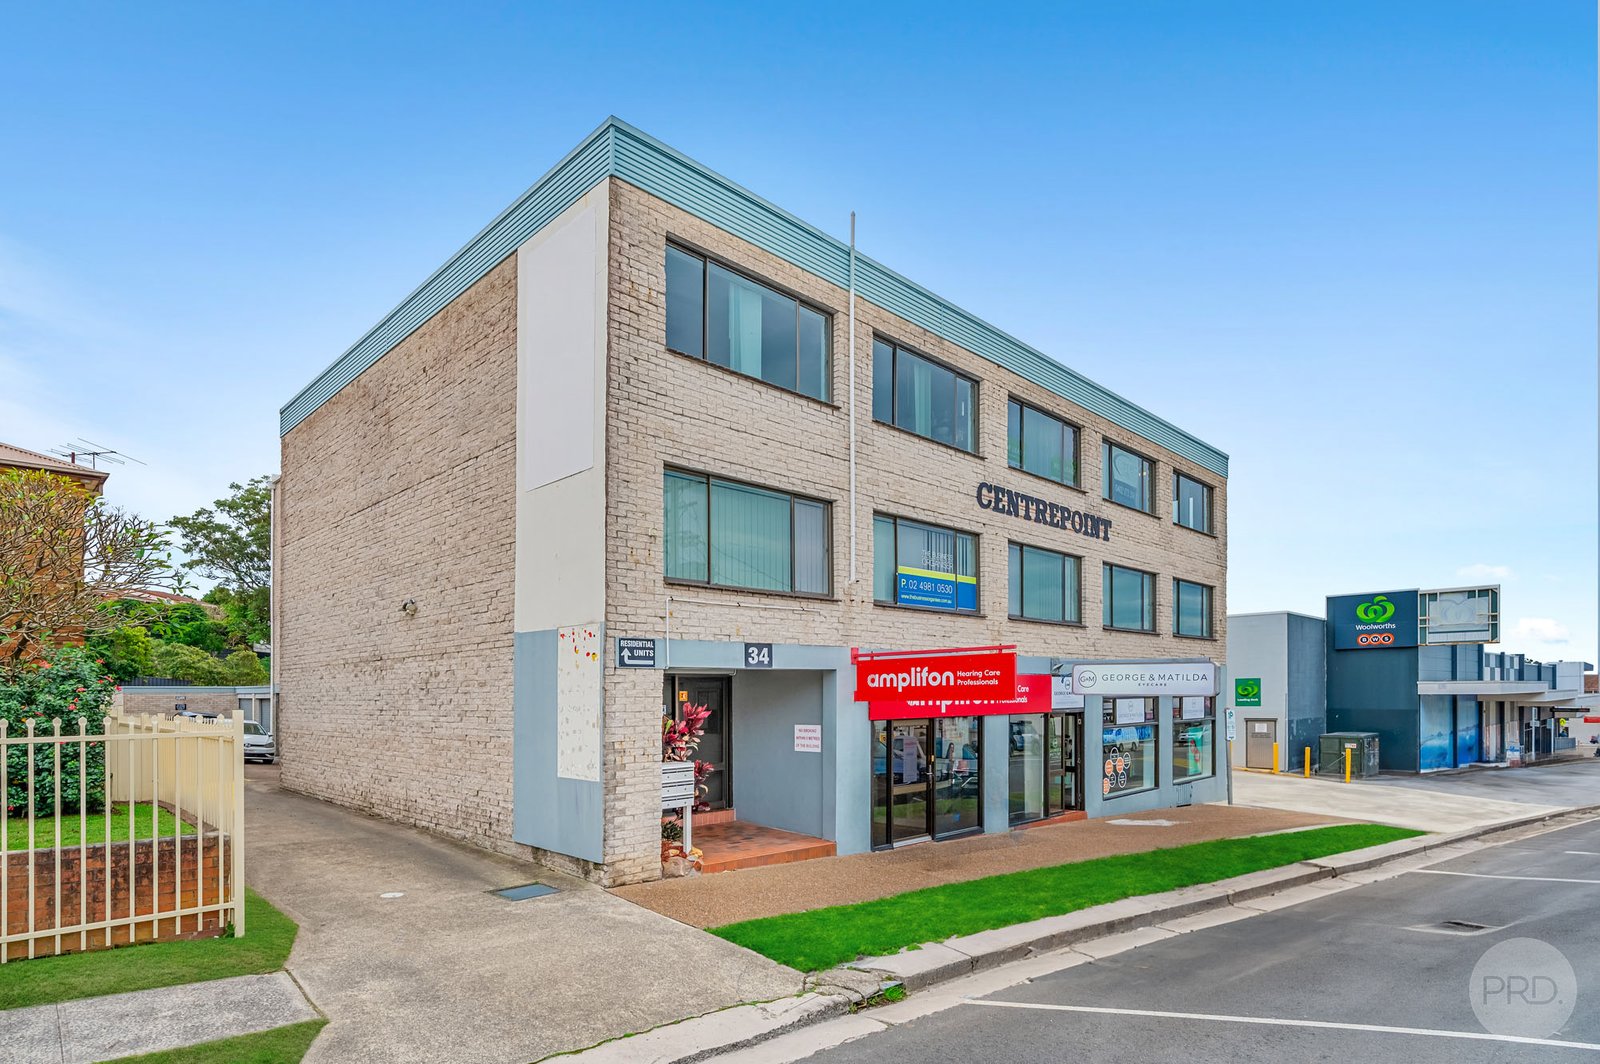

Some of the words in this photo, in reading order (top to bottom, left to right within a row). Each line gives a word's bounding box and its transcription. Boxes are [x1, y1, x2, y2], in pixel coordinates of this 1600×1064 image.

[976, 482, 1112, 541] CENTREPOINT
[909, 580, 918, 590] 02
[920, 582, 935, 592] 4981
[937, 584, 953, 594] 0530
[1355, 623, 1396, 631] Woolworths
[620, 640, 654, 648] RESIDENTIAL
[633, 649, 654, 657] UNITS
[748, 647, 770, 665] 34
[957, 670, 982, 679] Hearing
[1101, 673, 1146, 682] GEORGE
[1148, 673, 1155, 682] &
[1158, 673, 1208, 681] MATILDA
[867, 666, 955, 693] amplifon
[957, 678, 999, 686] Professionals
[1017, 684, 1030, 693] Care
